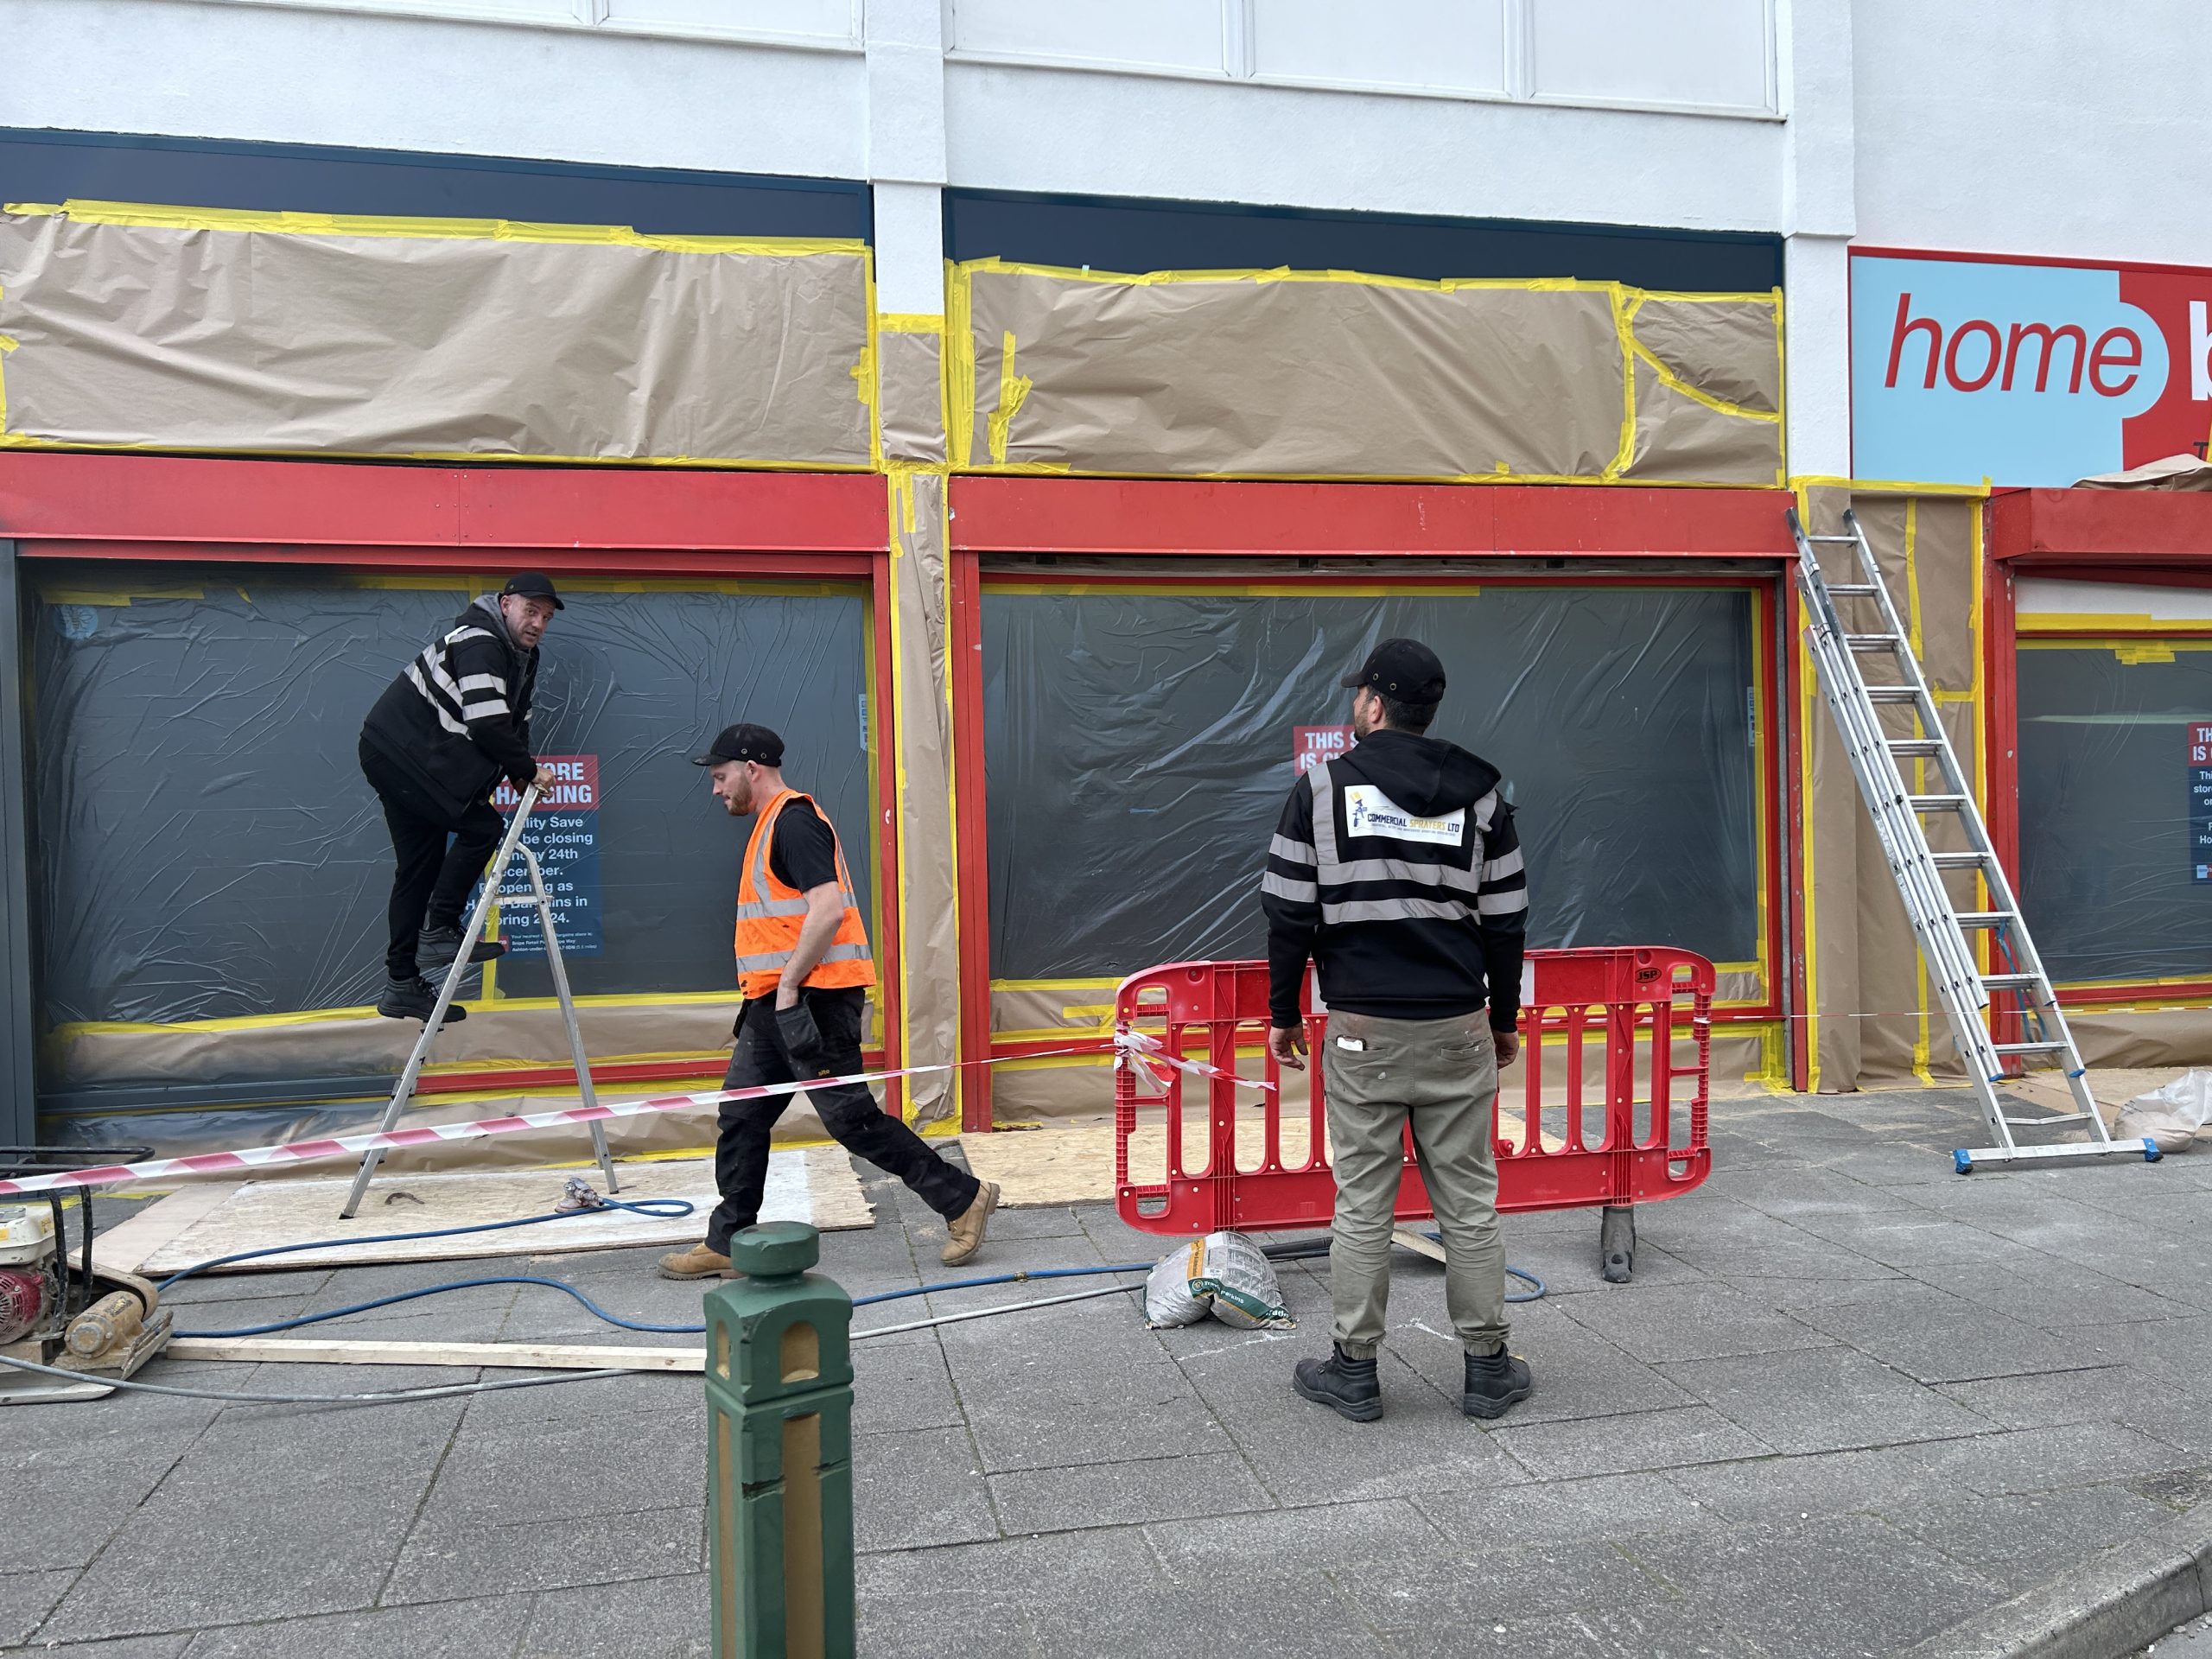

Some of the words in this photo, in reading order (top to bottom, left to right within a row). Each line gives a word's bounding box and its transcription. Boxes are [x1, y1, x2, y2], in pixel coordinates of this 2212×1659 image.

[1884, 292, 2143, 397] home
[1304, 731, 1344, 749] THIS
[2193, 745, 2207, 761] IS
[1300, 752, 1317, 770] IS
[535, 761, 585, 781] ORE
[495, 785, 593, 804] HAGING
[502, 817, 546, 830] Qlity
[550, 816, 583, 828] Save
[1367, 813, 1407, 827] COMMERCIAL
[1409, 818, 1446, 830] SPRAYERS
[1447, 822, 1460, 833] LTD
[522, 833, 540, 844] be
[543, 832, 594, 845] closing
[548, 849, 578, 860] 24th
[557, 882, 574, 892] as
[575, 895, 588, 907] in
[484, 913, 530, 927] pring
[533, 912, 570, 925] 224.
[1638, 969, 1658, 980] JSP
[1204, 1281, 1221, 1293] Trav
